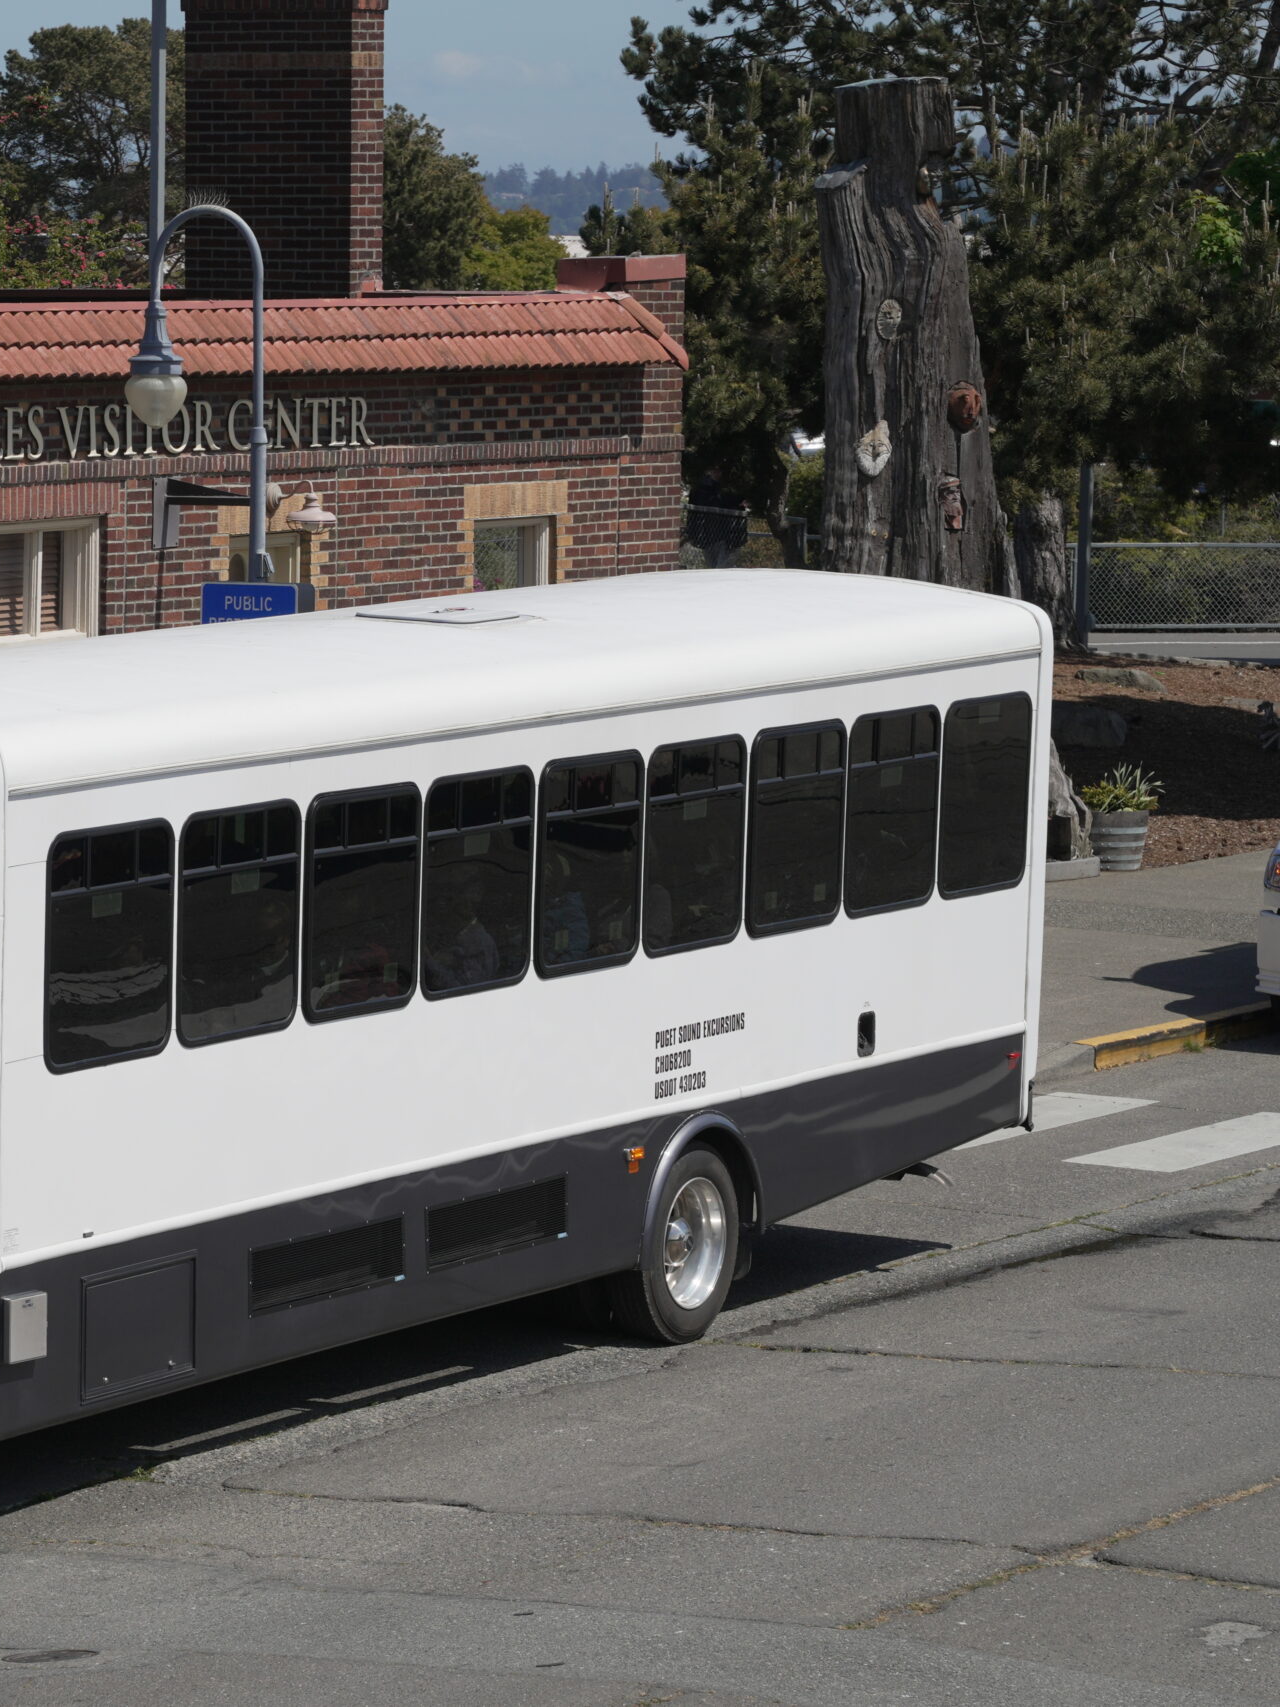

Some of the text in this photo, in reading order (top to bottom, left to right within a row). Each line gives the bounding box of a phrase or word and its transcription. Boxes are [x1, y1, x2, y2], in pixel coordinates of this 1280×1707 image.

[224, 595, 273, 612] PUBLIC
[655, 1012, 745, 1049] PUGET SOUND EXCURSIONS
[654, 1070, 706, 1099] USDOT 430203
